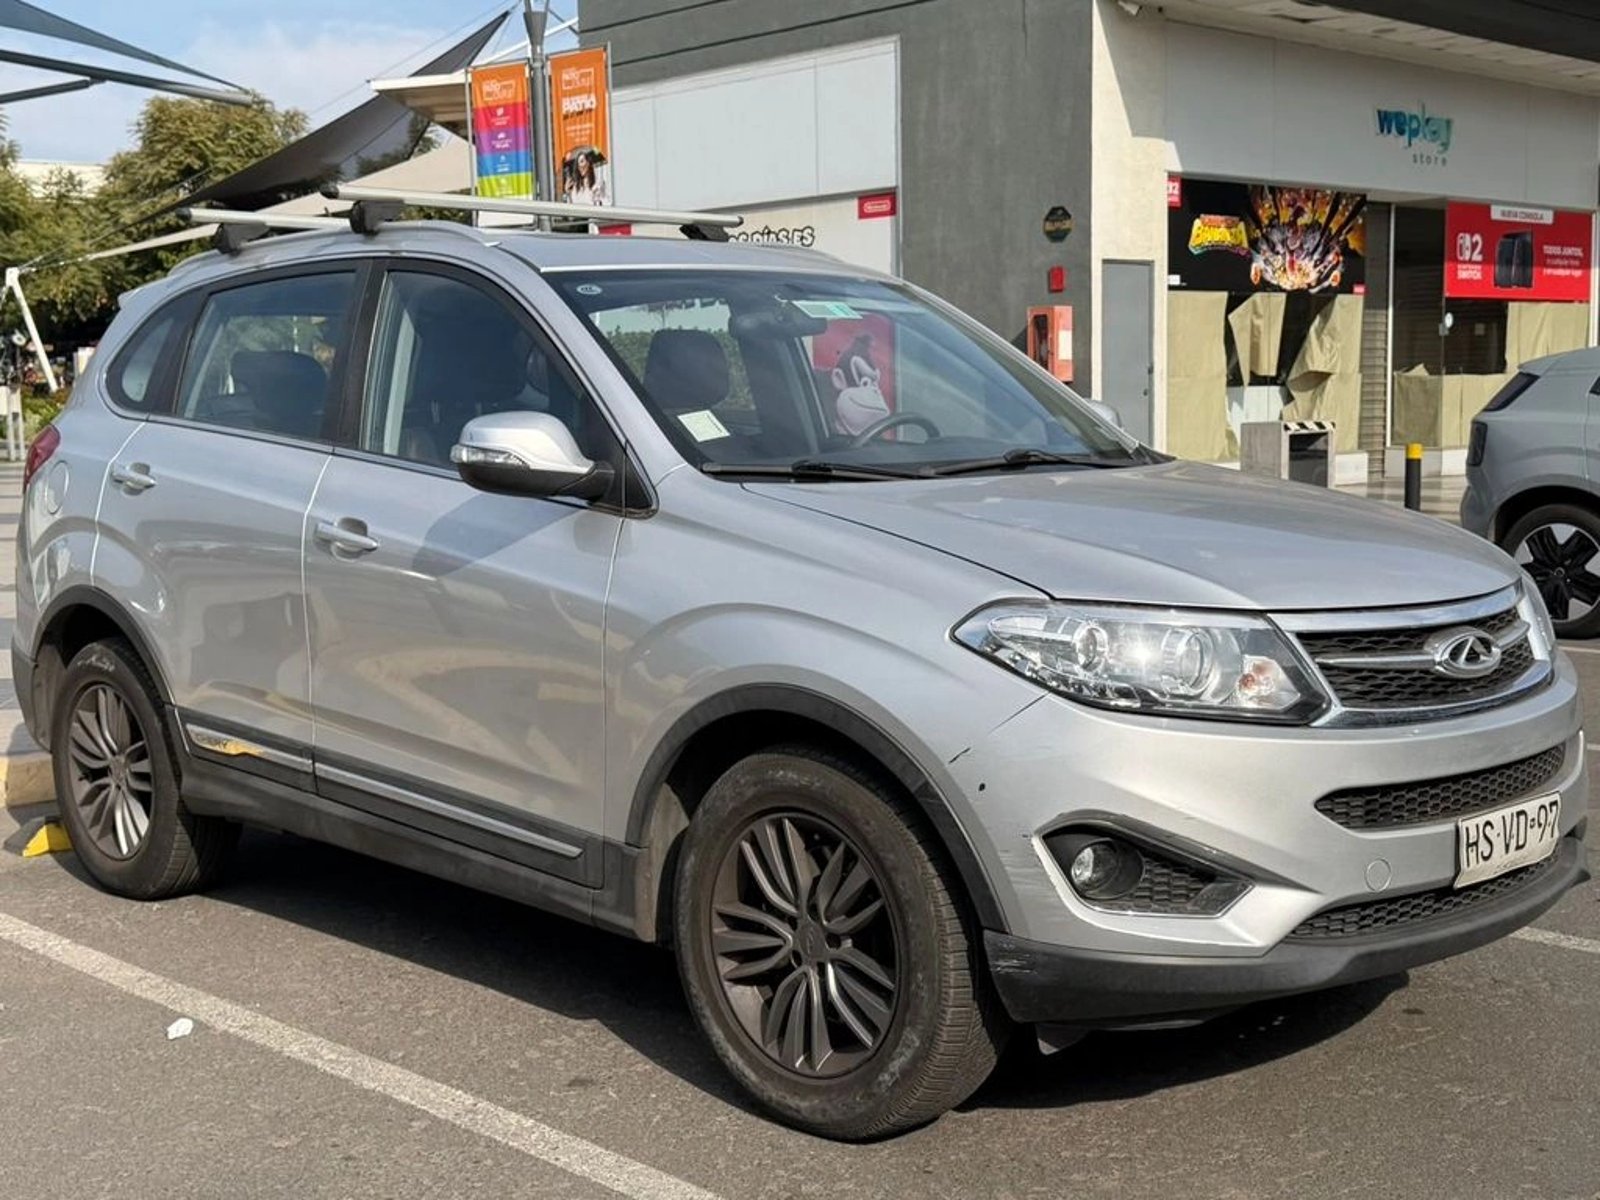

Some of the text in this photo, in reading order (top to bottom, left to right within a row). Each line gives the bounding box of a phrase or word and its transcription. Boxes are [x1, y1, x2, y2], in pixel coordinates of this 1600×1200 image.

[1376, 103, 1453, 153] weplay
[1412, 153, 1447, 166] store
[791, 226, 815, 247] ES
[1472, 233, 1483, 261] 2
